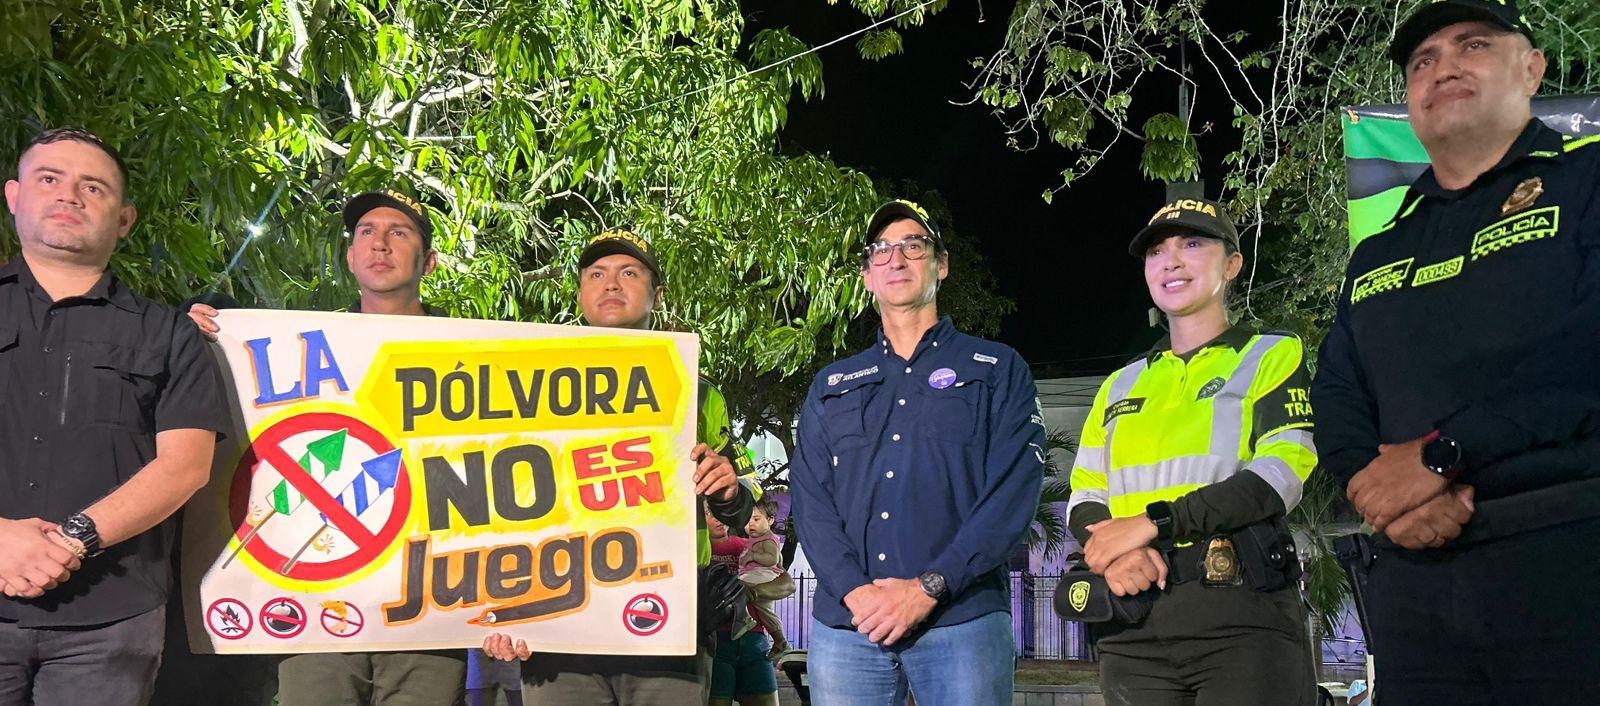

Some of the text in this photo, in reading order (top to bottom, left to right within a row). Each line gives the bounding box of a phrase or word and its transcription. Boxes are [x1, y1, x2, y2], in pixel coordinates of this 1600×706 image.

[244, 329, 661, 432] LA PÓLVORA
[422, 444, 557, 531] NO
[572, 435, 654, 480] ES
[578, 471, 665, 511] UN
